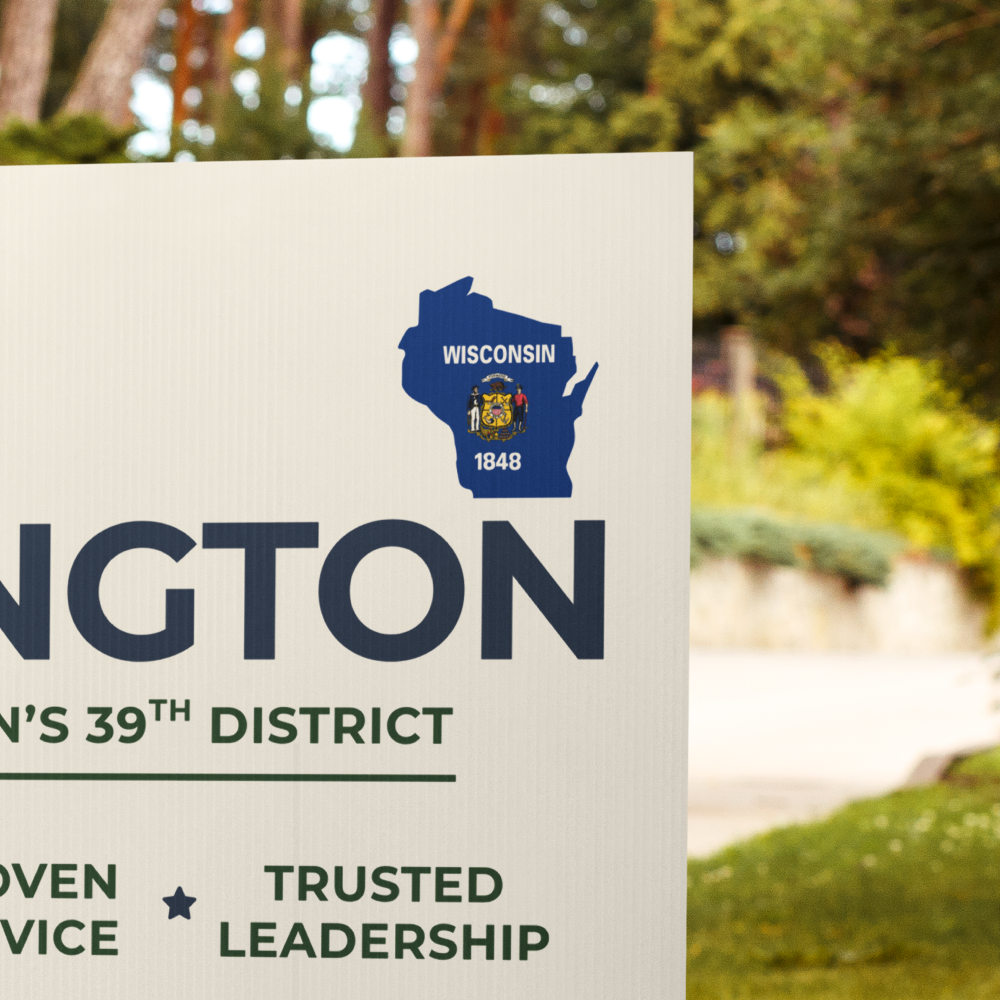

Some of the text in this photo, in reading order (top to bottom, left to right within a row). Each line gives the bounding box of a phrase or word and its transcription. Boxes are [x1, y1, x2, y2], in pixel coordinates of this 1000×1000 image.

[443, 344, 555, 364] WISCONSIN
[474, 452, 522, 471] 1848
[86, 698, 191, 744] 39TH
[211, 706, 454, 745] DISTRICT
[263, 865, 504, 904] TRUSTED
[219, 921, 550, 961] LEADERSHIP
